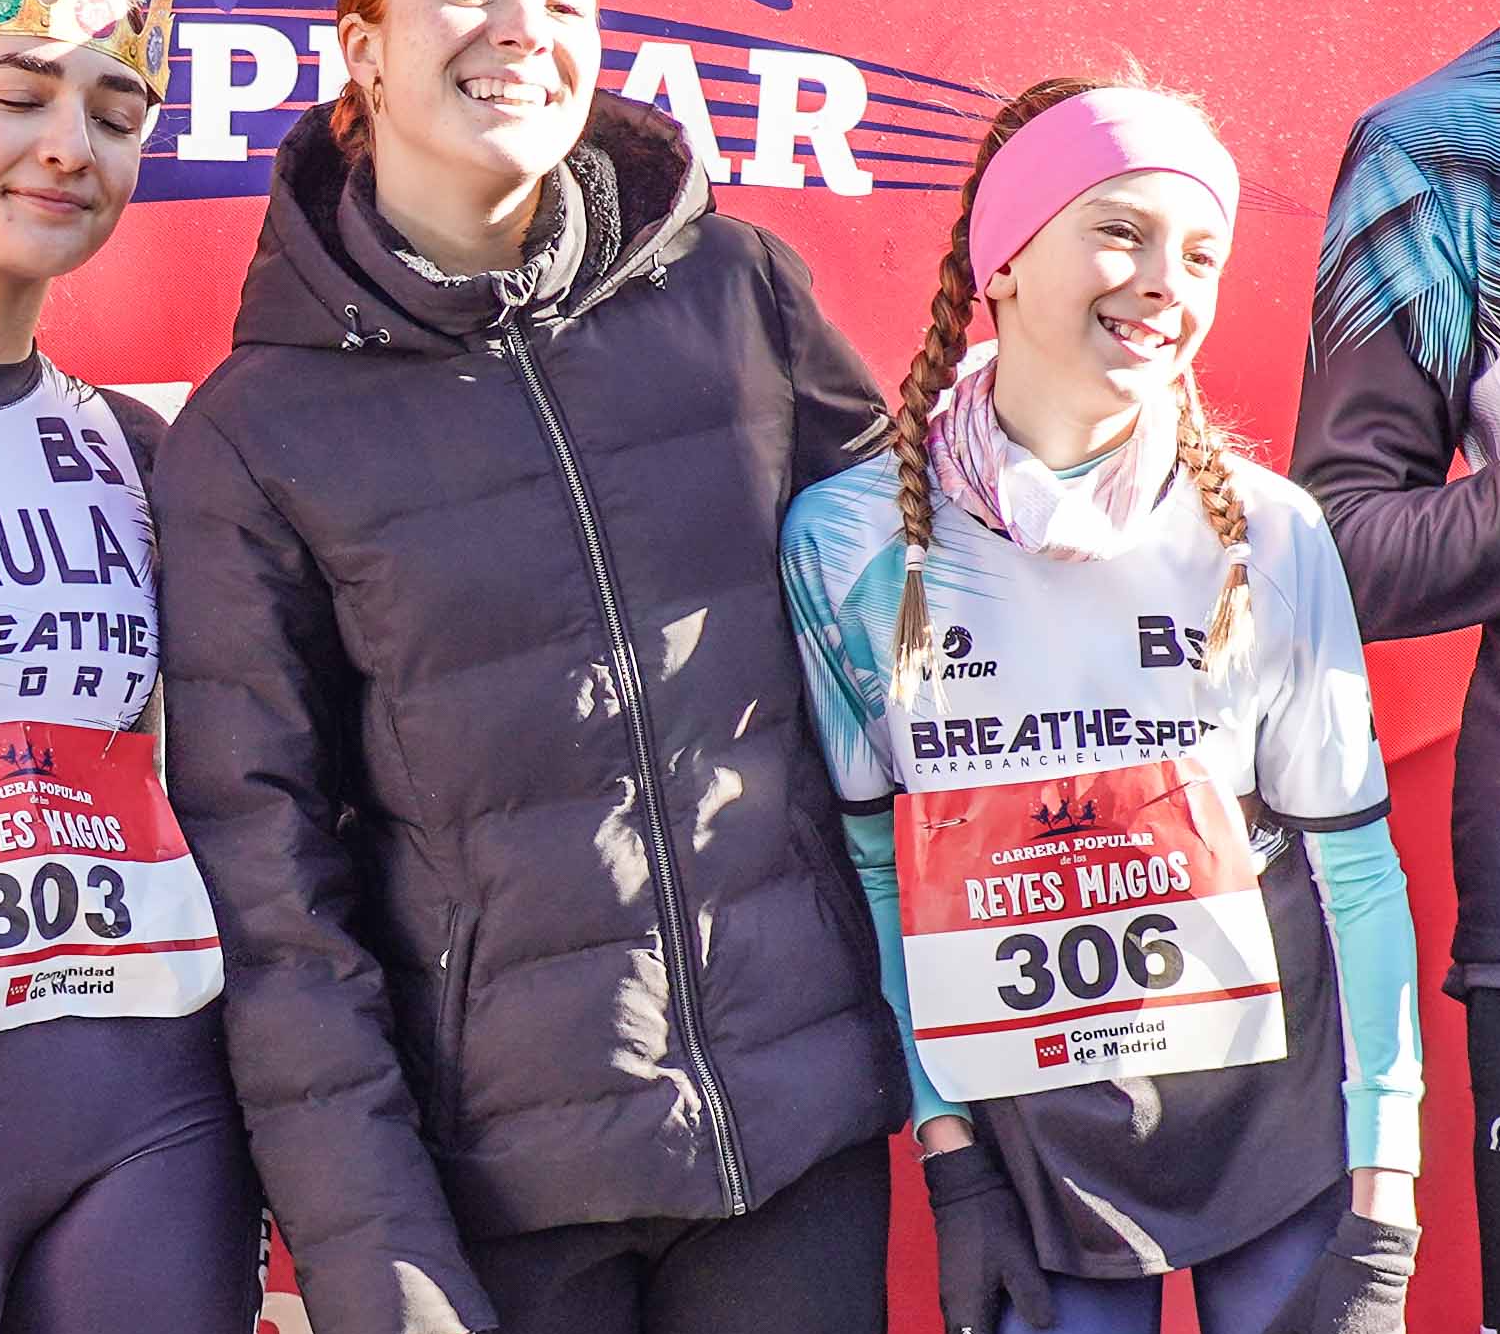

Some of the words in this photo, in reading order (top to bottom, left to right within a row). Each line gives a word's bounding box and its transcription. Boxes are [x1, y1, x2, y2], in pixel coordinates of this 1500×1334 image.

[37, 417, 124, 485] BS
[915, 750, 1101, 774] CARABANCHEL
[40, 781, 94, 805] POPULAR
[41, 808, 126, 853] MAGOS
[991, 841, 1069, 866] CARRERA
[1073, 833, 1154, 852] POPULAR
[1060, 854, 1071, 865] de
[1072, 853, 1087, 865] los
[965, 871, 1065, 921] REYES
[1078, 850, 1191, 908] MAGOS
[995, 914, 1185, 1011] 306
[35, 966, 115, 984] Comunidad
[30, 984, 46, 999] de
[52, 981, 114, 996] Madrid
[1070, 1019, 1166, 1043] Comunidad
[1073, 1044, 1097, 1062] de
[1103, 1037, 1167, 1058] Madrid
